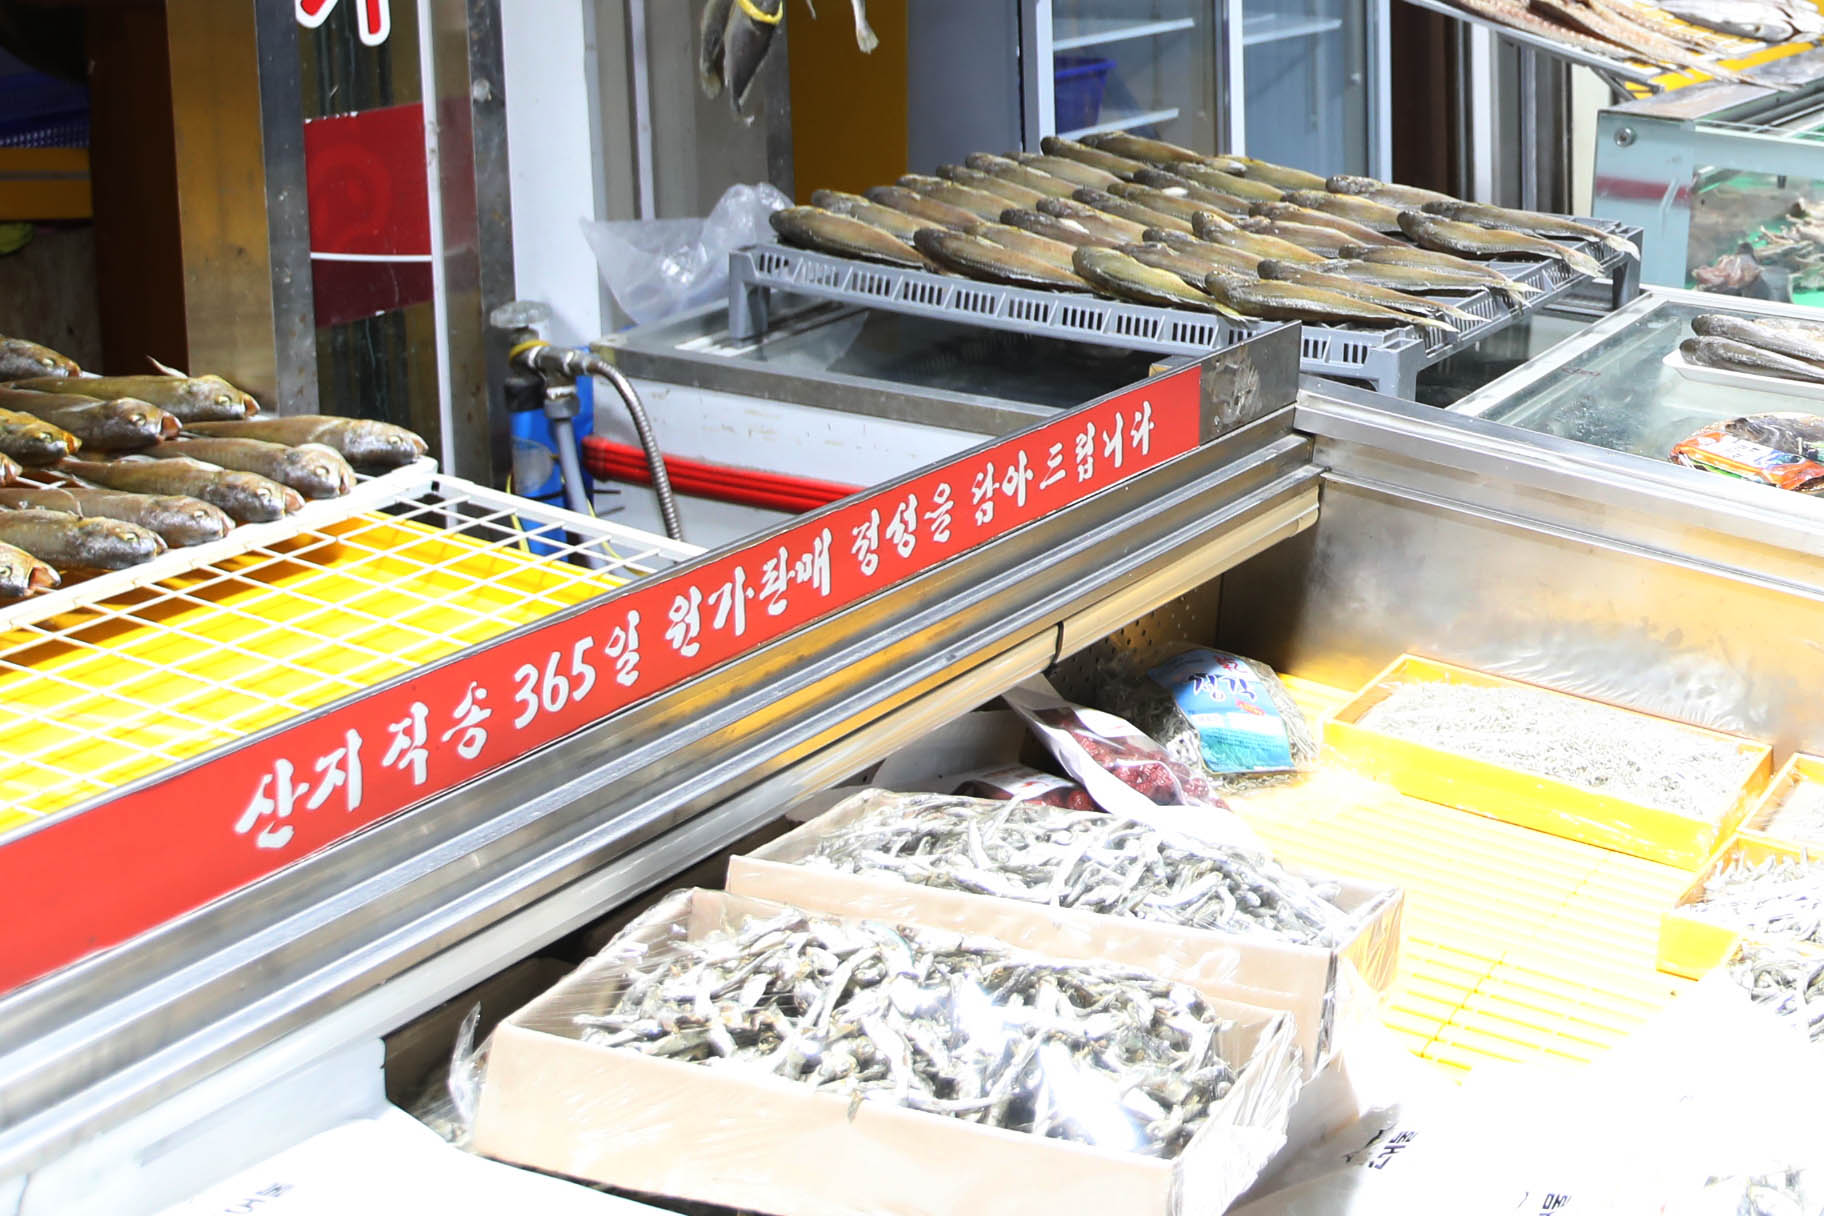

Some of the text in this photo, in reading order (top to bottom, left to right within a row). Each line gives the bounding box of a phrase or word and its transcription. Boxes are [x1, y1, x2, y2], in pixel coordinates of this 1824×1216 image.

[513, 609, 641, 729] 365일
[664, 528, 832, 657] 원가판매
[850, 482, 955, 577] 정성을
